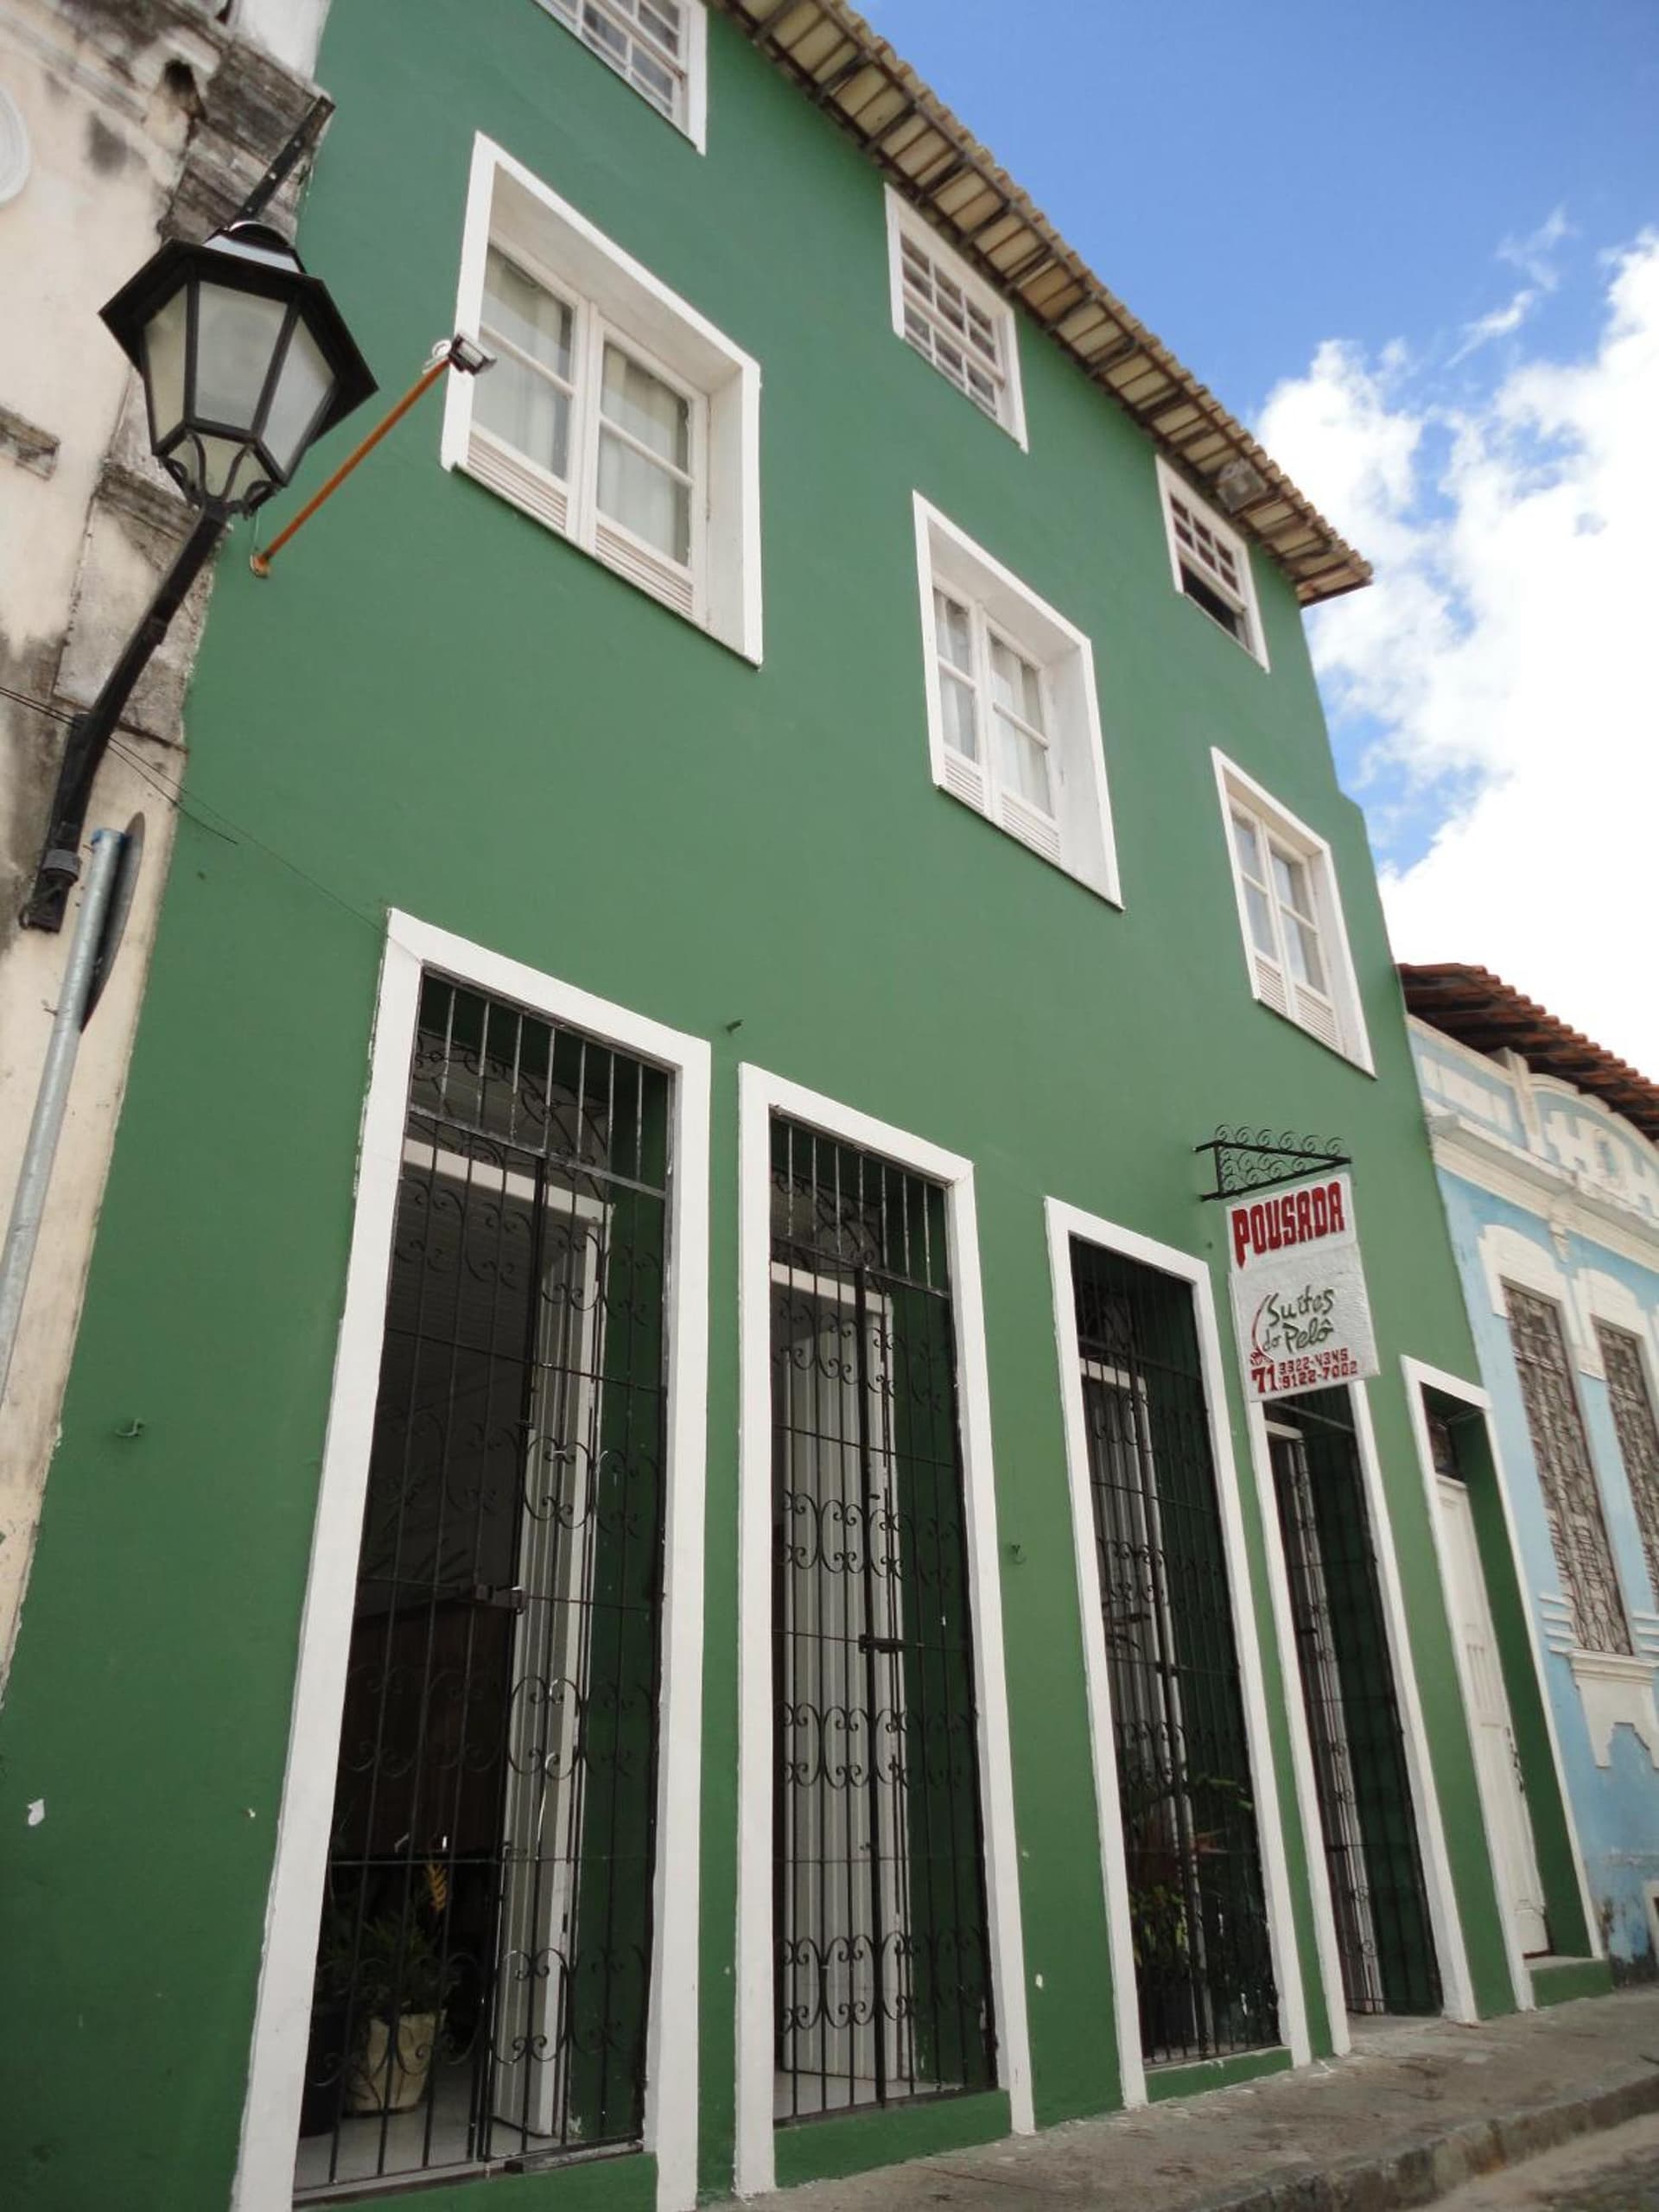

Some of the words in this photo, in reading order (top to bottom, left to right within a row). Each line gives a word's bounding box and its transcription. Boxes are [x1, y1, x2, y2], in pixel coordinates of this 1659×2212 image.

[1231, 1181, 1344, 1269] POUSADA
[1262, 1328, 1281, 1351] do
[1282, 1317, 1334, 1353] Pelô
[1250, 1364, 1278, 1394] 71
